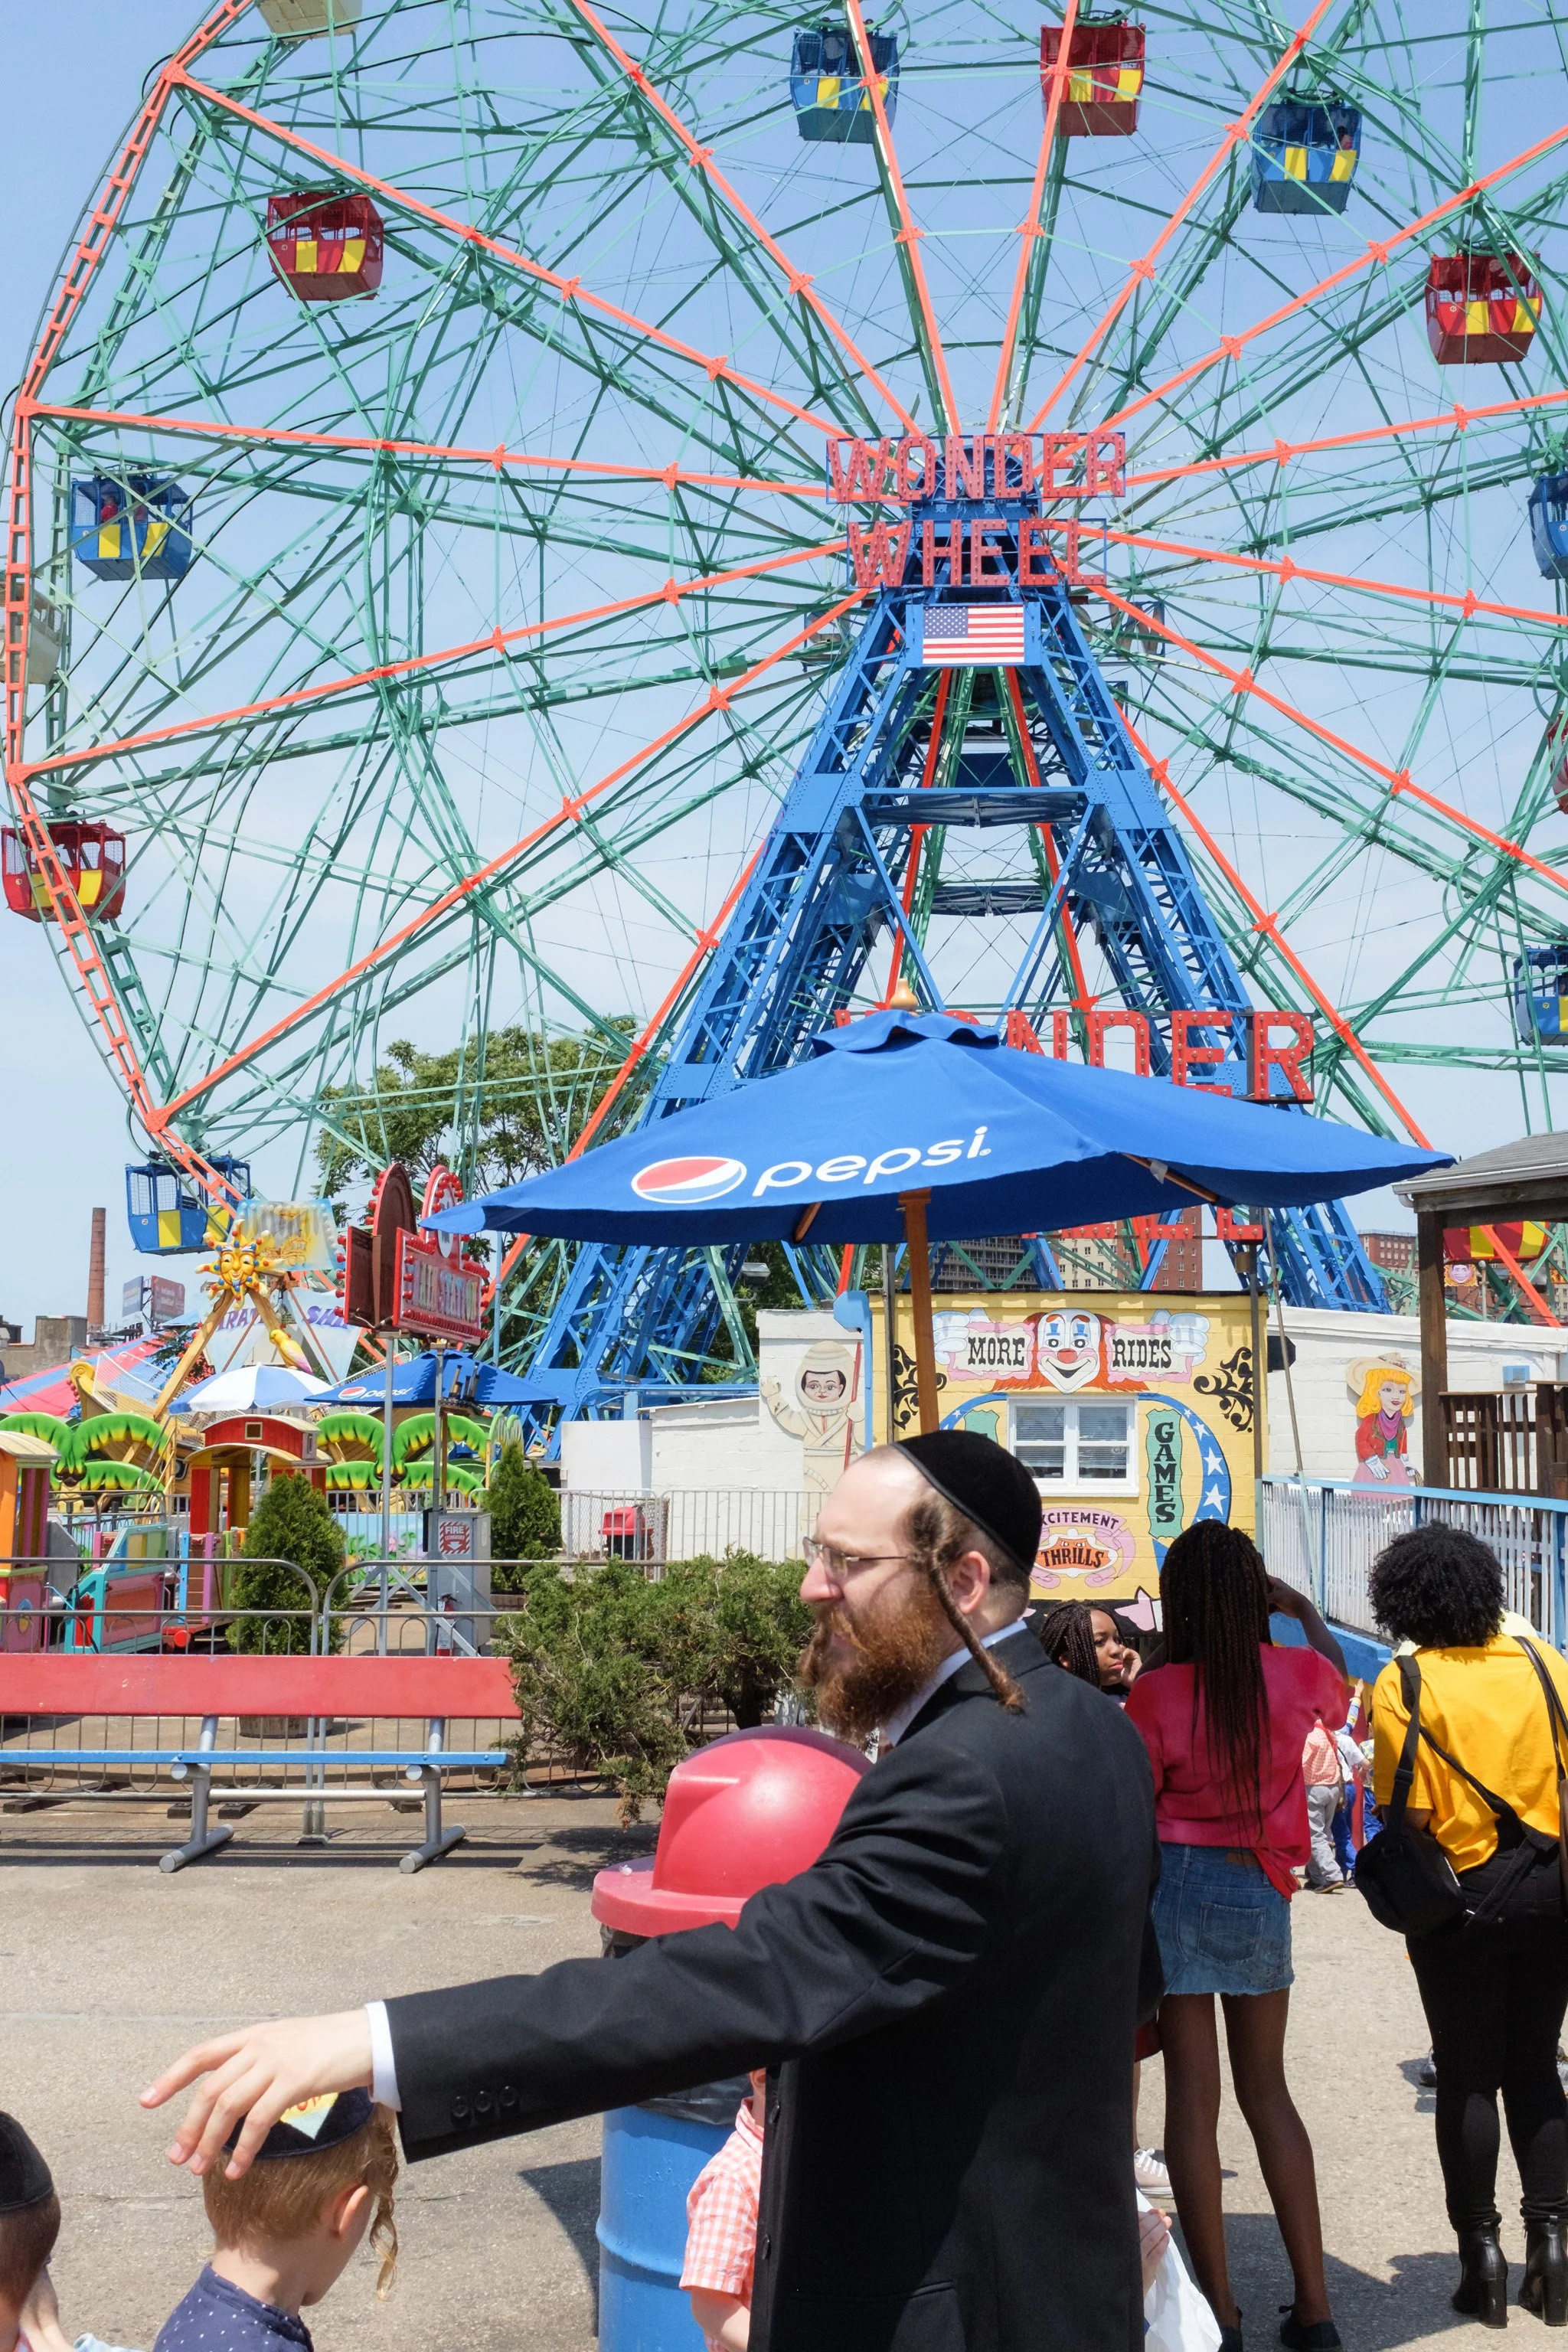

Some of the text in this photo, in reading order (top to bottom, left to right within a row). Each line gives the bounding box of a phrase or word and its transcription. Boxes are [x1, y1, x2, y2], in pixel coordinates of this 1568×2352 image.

[826, 433, 1125, 503] WONDER
[848, 519, 1107, 586] WHEEL
[835, 1010, 1315, 1103] NDER
[753, 1125, 988, 1197] pepsi
[968, 1337, 1172, 1368] MORE RIDES
[1153, 1422, 1178, 1523] GAMES
[445, 1526, 464, 1534] FIRE
[1042, 1511, 1119, 1529] XCITEMENT
[1041, 1547, 1104, 1568] THRILLS
